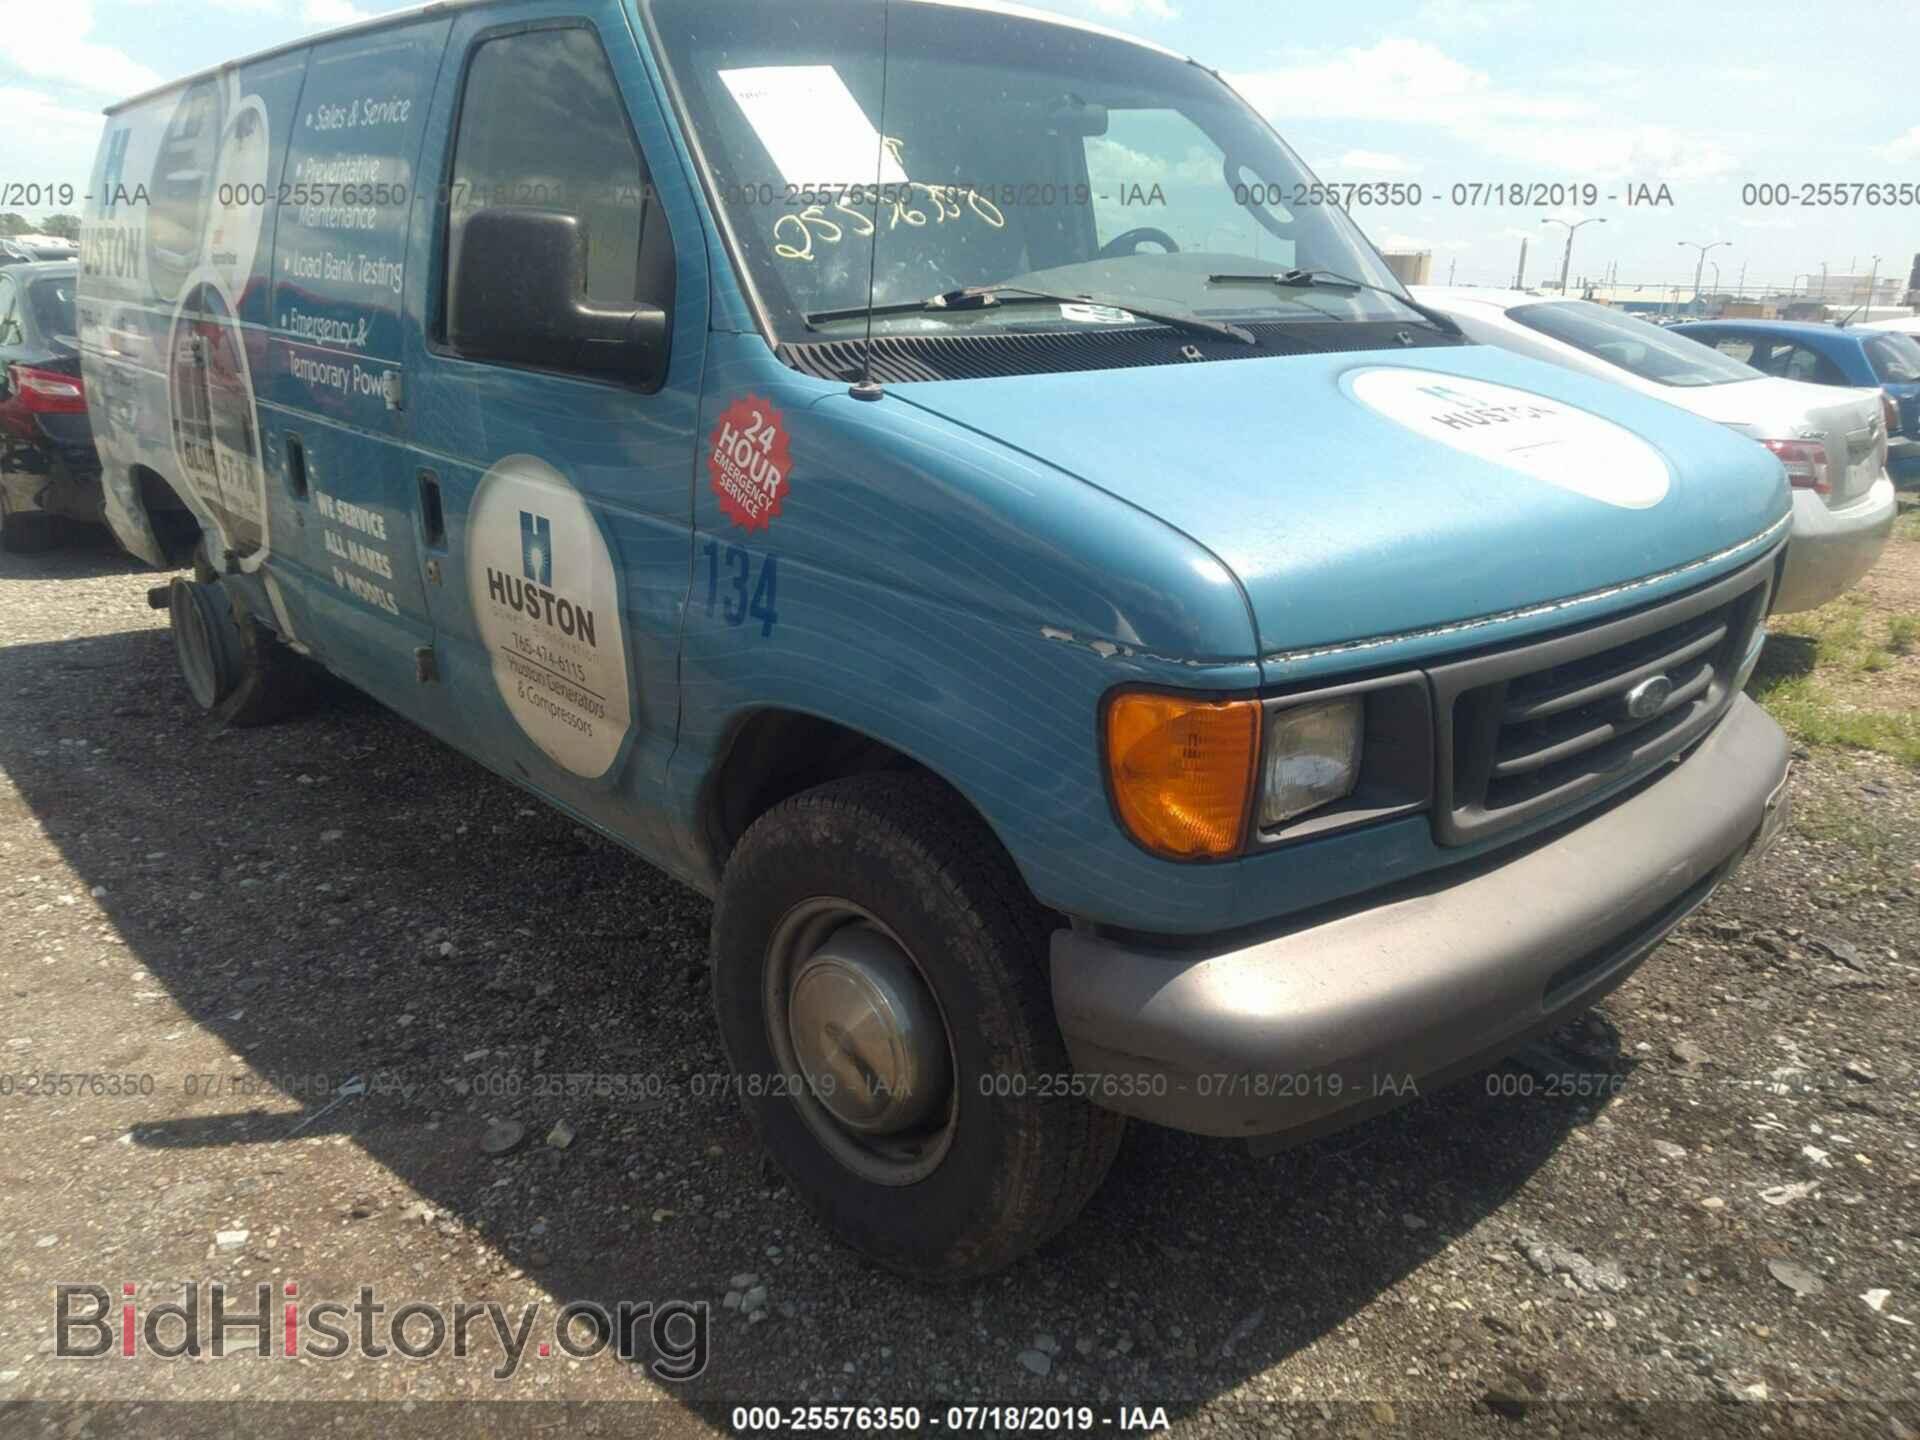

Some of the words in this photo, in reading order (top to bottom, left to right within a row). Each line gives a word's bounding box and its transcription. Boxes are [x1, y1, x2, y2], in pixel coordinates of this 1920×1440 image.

[316, 104, 347, 130] Sales
[361, 97, 410, 126] Service
[80, 225, 143, 279] USTON
[294, 251, 320, 278] Load
[322, 252, 354, 281] Bank
[358, 254, 404, 294] Testing
[290, 307, 354, 349] Emergency
[288, 350, 349, 395] Temporary
[743, 410, 776, 454] 24
[713, 447, 772, 511] EMERGENCY
[719, 421, 781, 498] HOUR
[719, 472, 759, 519] SERVICE
[335, 499, 387, 541] SERVICE
[487, 567, 596, 648] HUSTON
[703, 540, 778, 638] 134
[526, 685, 593, 738] Compressors
[547, 674, 605, 720] Generators
